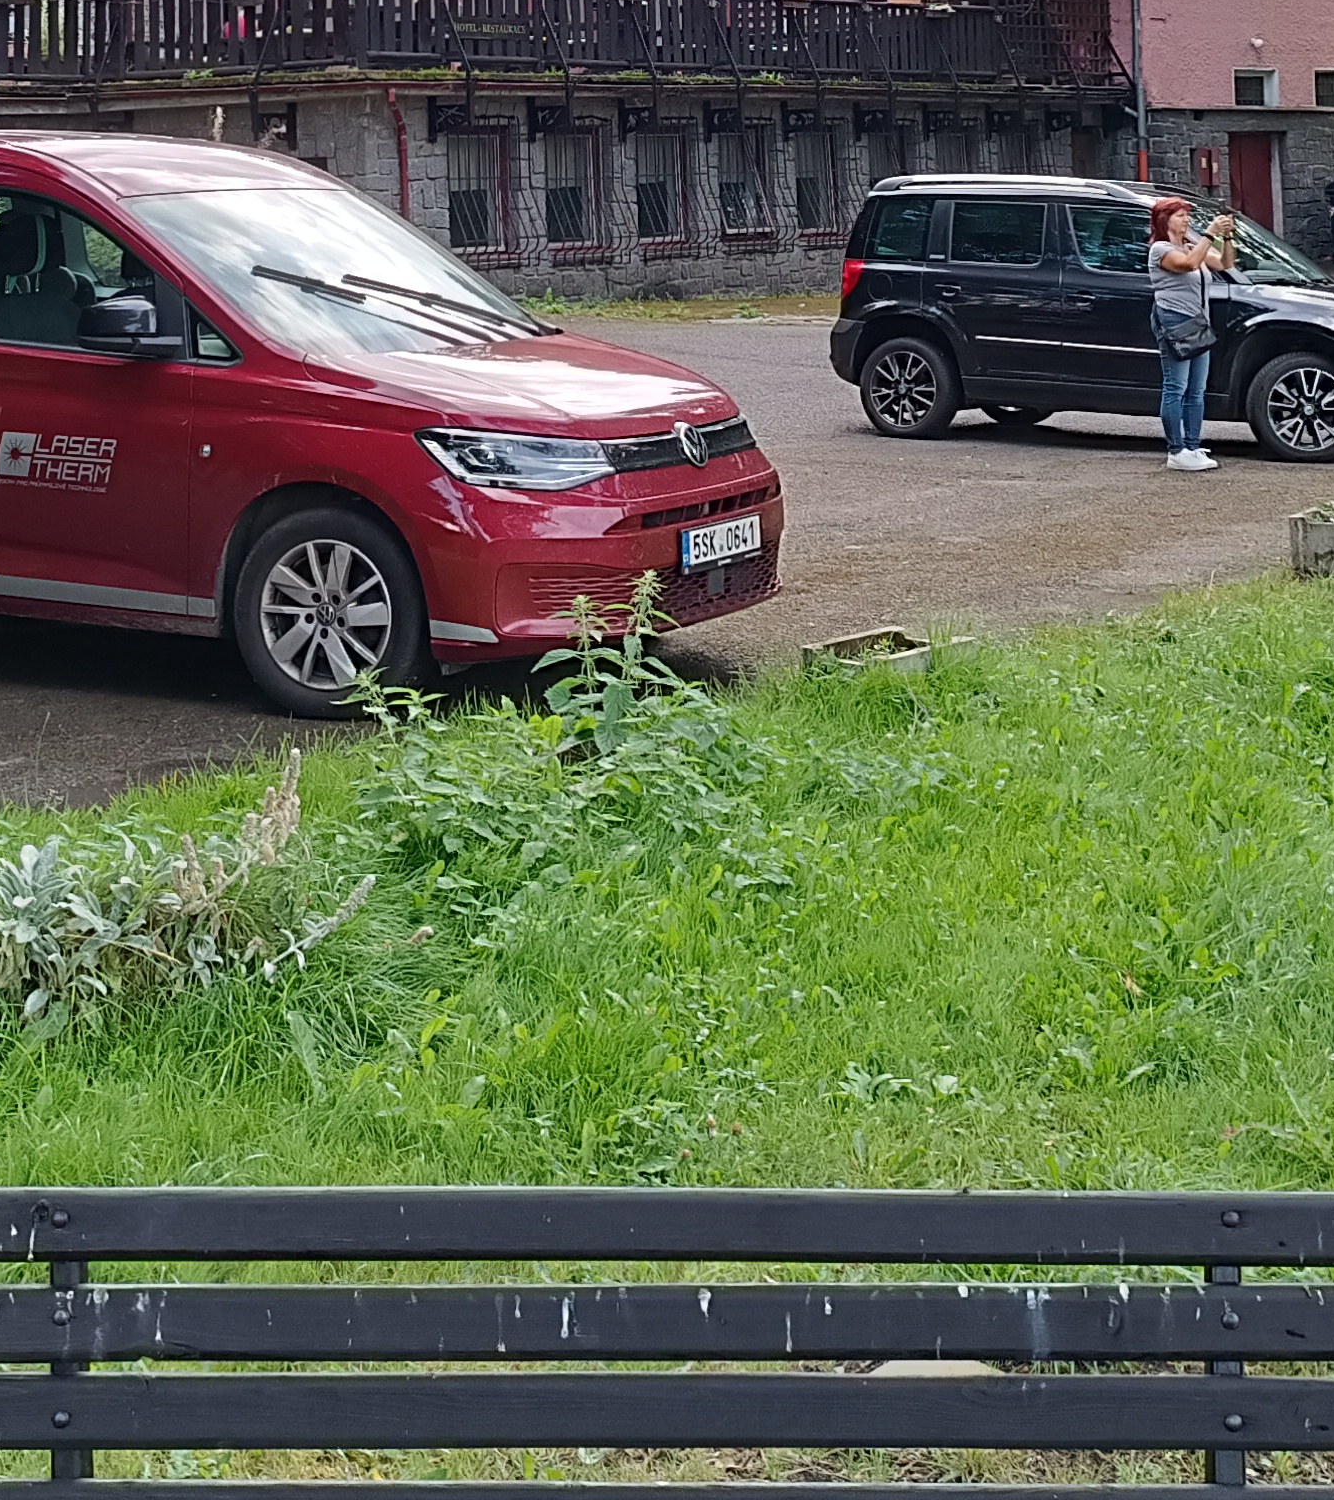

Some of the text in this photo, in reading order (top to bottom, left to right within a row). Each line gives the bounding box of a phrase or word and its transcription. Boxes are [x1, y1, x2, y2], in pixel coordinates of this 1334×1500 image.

[35, 433, 117, 458] LASER
[32, 460, 111, 484] THERM
[693, 521, 755, 560] 5SK 0641
